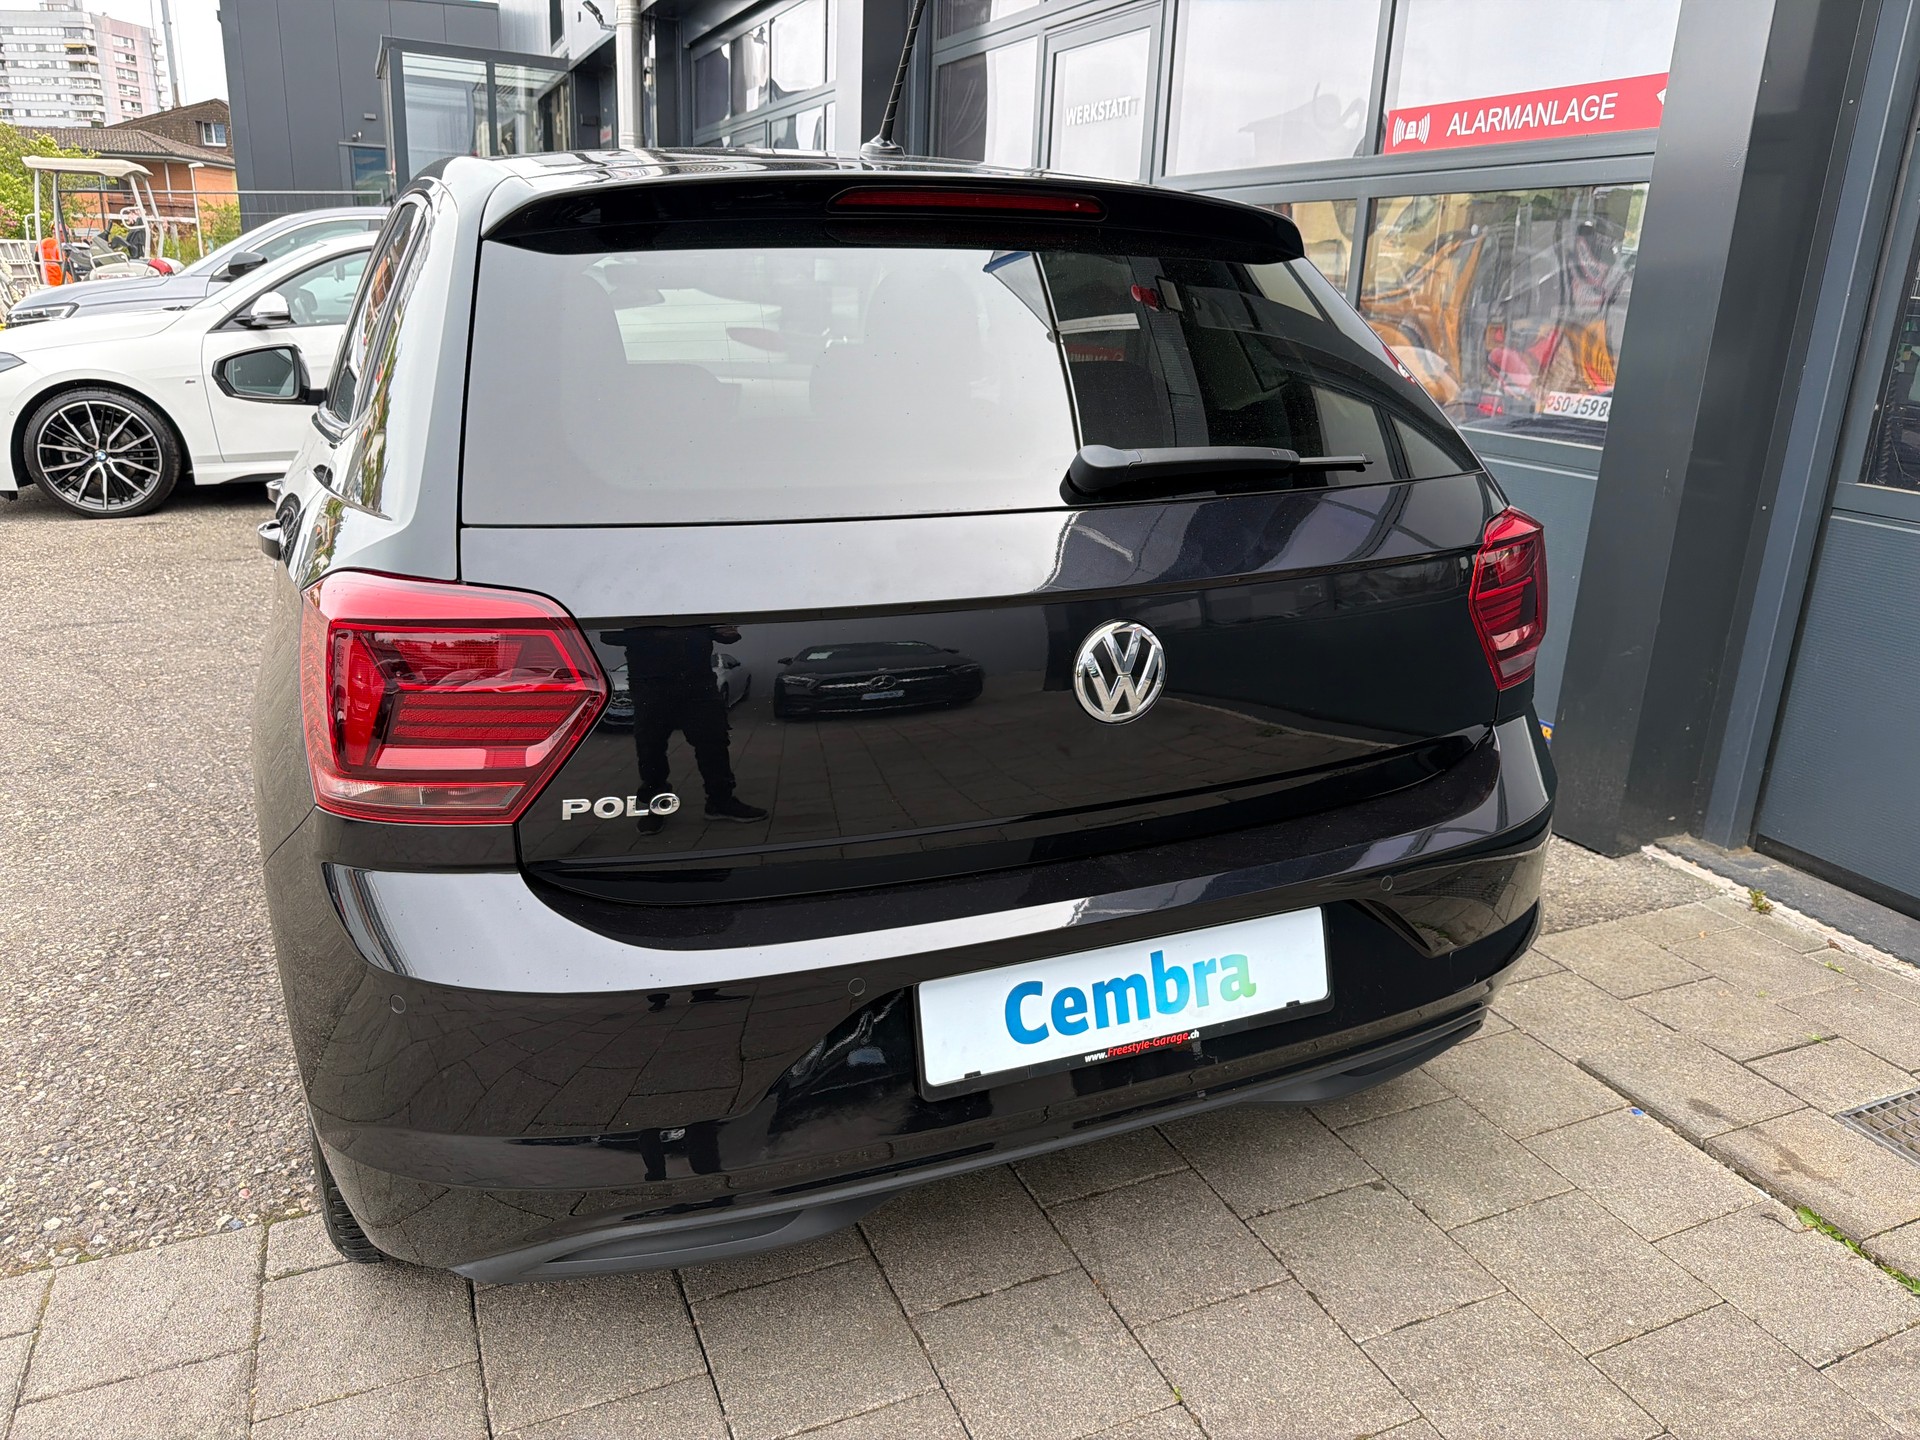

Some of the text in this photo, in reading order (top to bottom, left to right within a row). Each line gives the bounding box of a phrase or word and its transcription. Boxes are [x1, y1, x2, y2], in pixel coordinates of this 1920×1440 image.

[1065, 95, 1133, 127] WERKSTATT
[1446, 92, 1619, 137] ALARMANLAGE
[561, 792, 681, 821] POLO
[1004, 949, 1257, 1045] Cembra
[1084, 1029, 1200, 1063] www.Freestyle-Garage.ch
